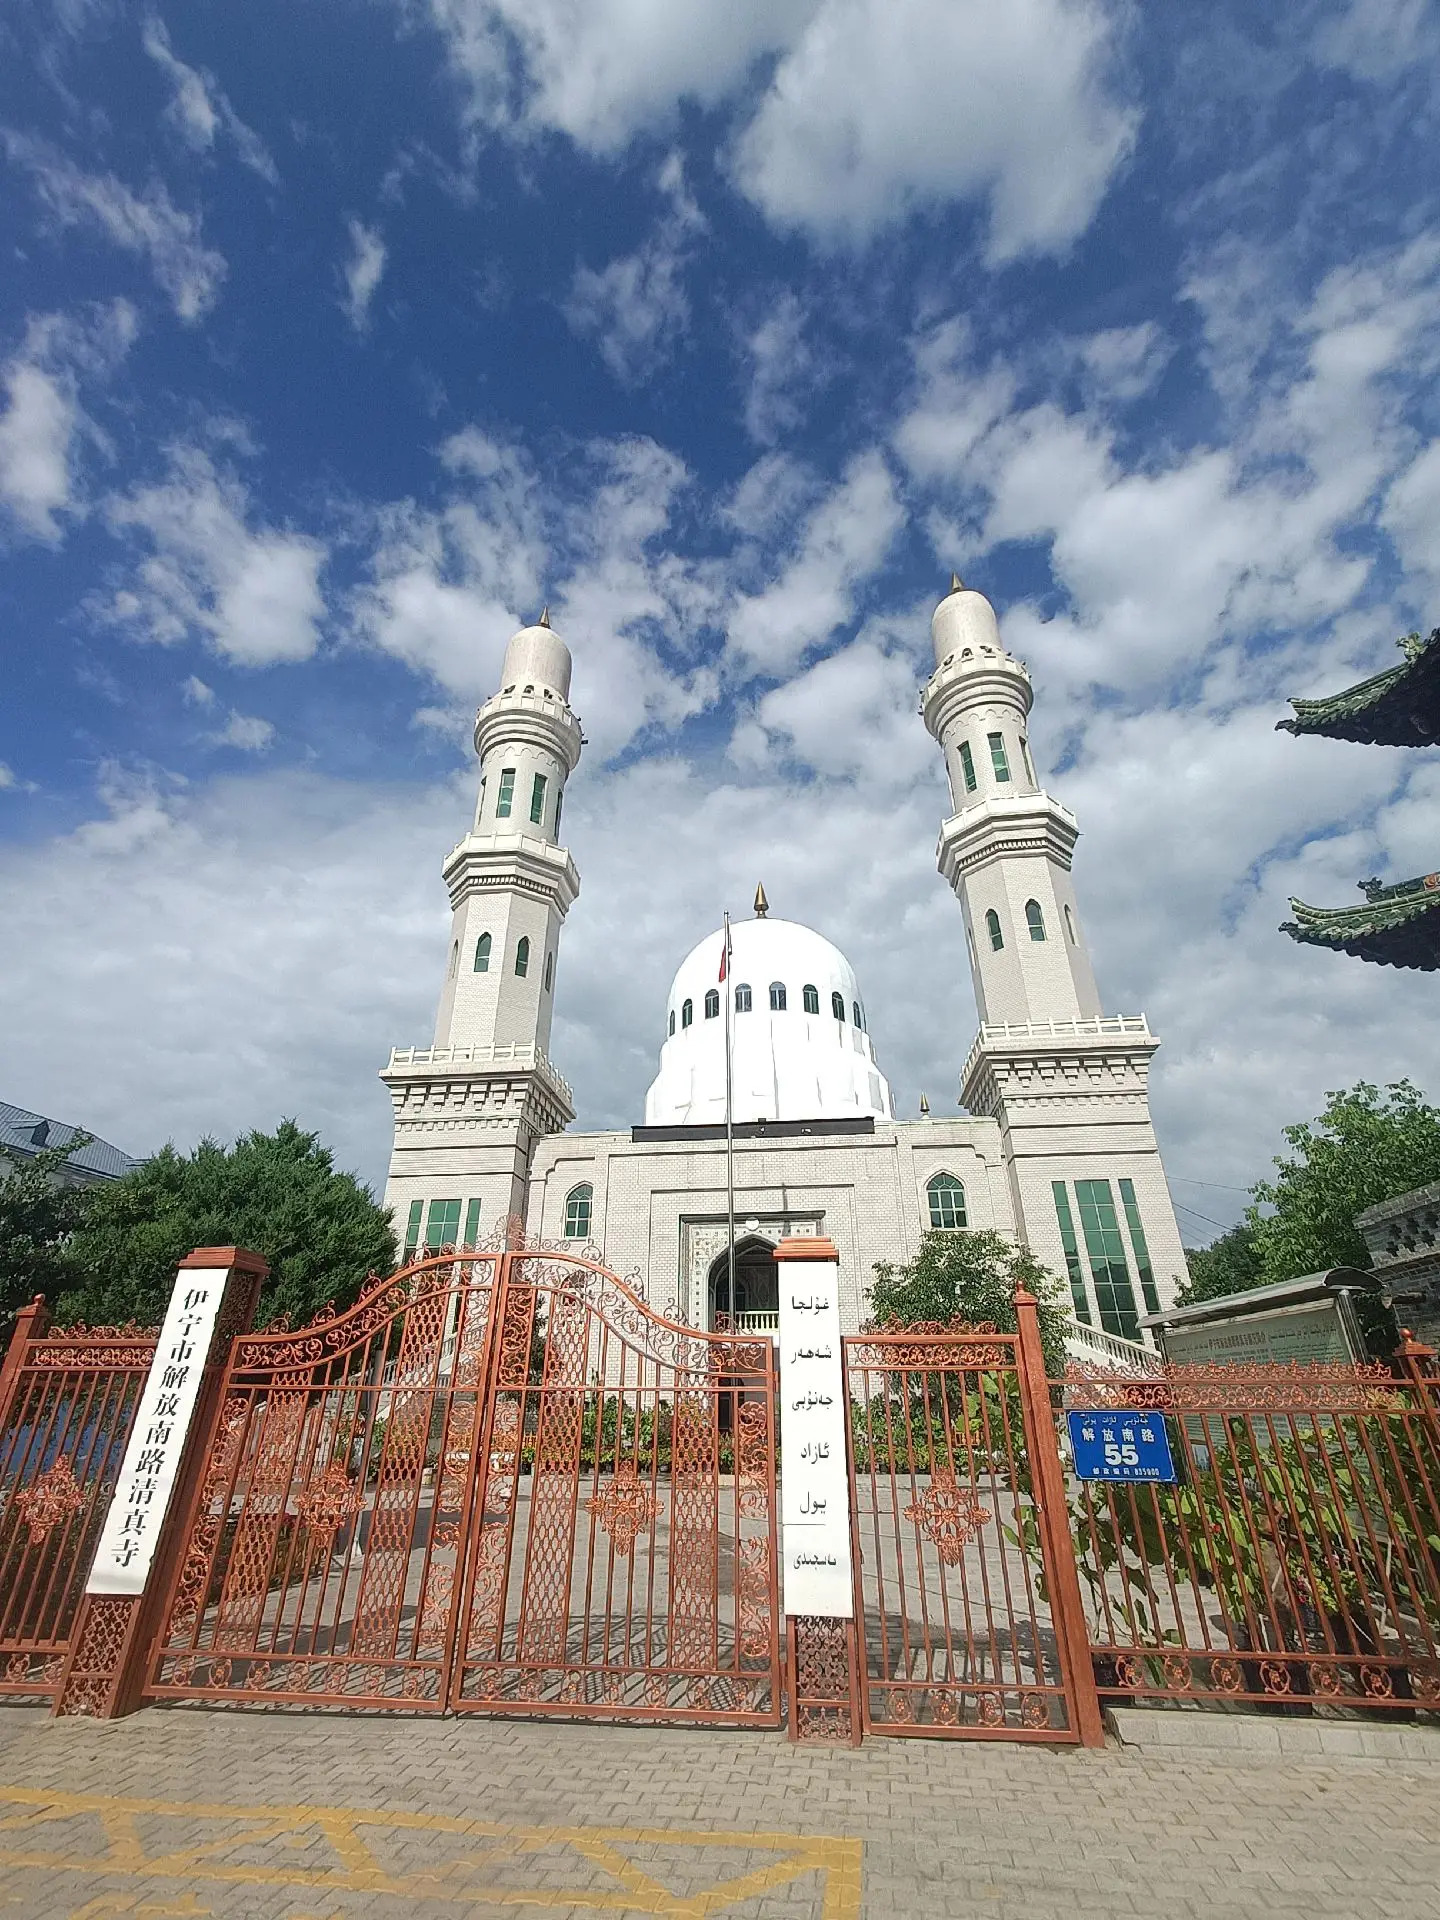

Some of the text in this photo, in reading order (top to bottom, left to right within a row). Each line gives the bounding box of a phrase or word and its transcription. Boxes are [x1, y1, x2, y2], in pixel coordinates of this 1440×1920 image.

[111, 1288, 209, 1568] 伊宁市解放南路清真寺
[1081, 1428, 1155, 1442] 解放南路
[1104, 1444, 1139, 1466] 55
